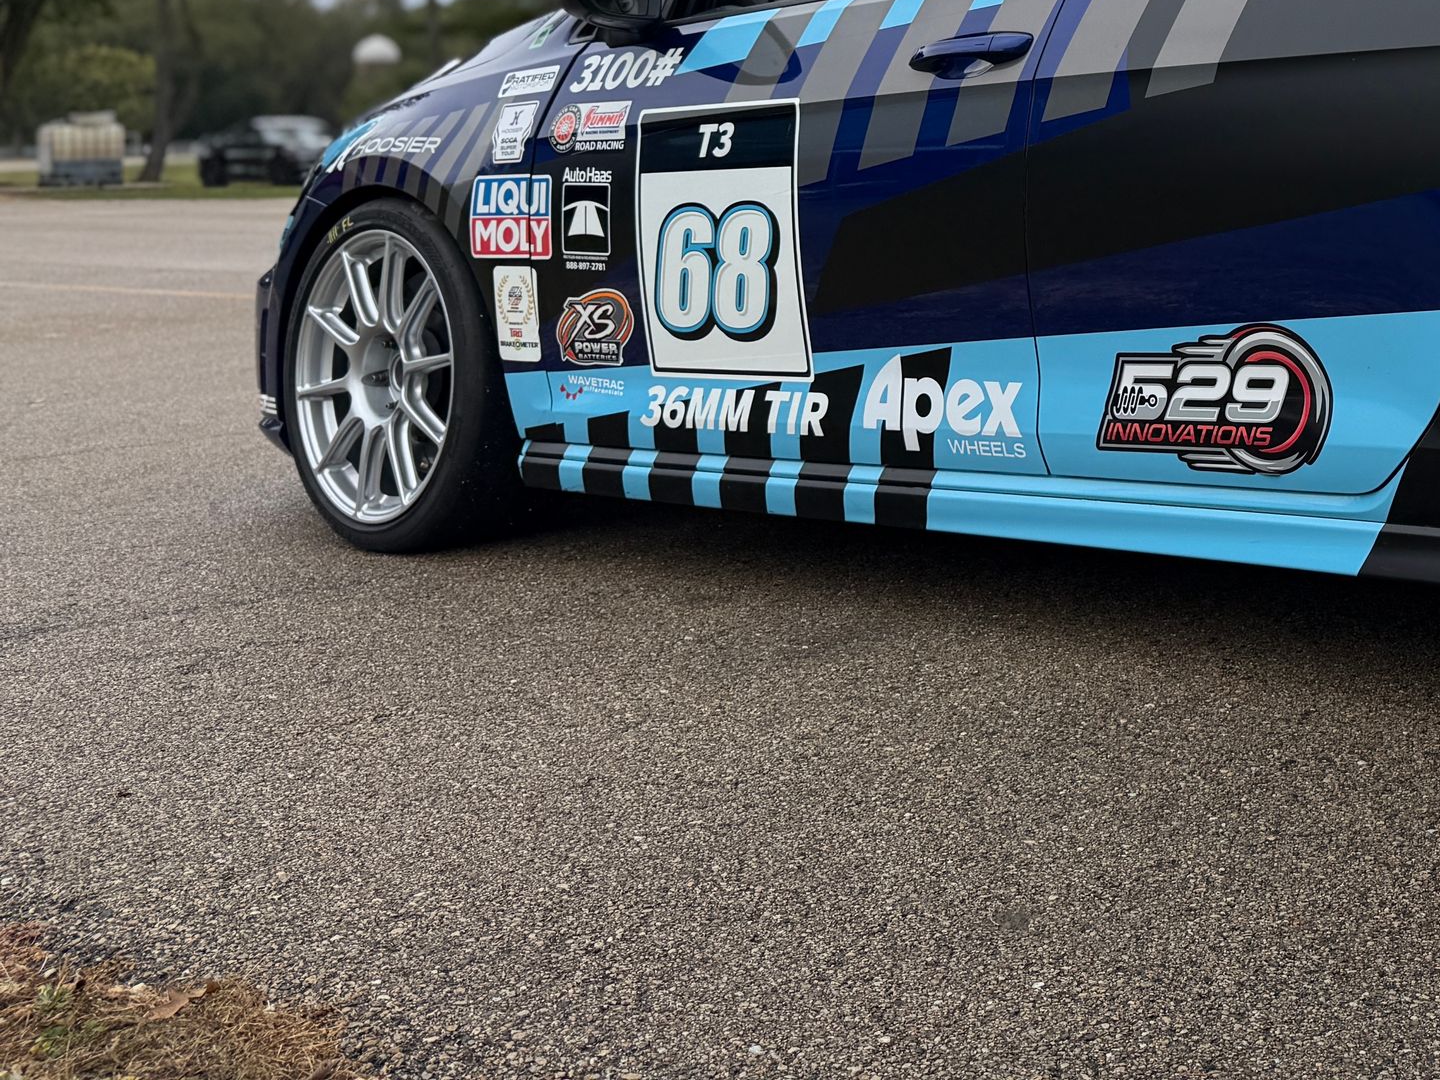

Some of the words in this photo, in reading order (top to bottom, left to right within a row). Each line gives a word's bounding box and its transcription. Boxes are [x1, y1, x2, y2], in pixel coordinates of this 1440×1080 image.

[569, 47, 685, 94] 3100#
[582, 106, 629, 131] SUMMIT
[352, 136, 442, 155] HOOSIER
[575, 141, 596, 151] ROAD
[596, 140, 625, 151] RACING
[699, 122, 735, 159] T3
[476, 180, 547, 216] LIQUI
[475, 219, 548, 253] MOLY
[566, 261, 606, 271] 888-897-2781
[654, 199, 780, 343] 68
[565, 304, 615, 348] XS
[574, 341, 618, 354] POWER
[568, 374, 625, 390] WAVETRAC
[583, 385, 624, 396] differentials
[1114, 363, 1290, 424] 529
[640, 385, 755, 433] 36MM
[764, 389, 829, 437] TIR
[862, 353, 1023, 452] Apex
[947, 438, 1027, 459] WHEELS
[1107, 422, 1273, 446] INNOVATIONS
